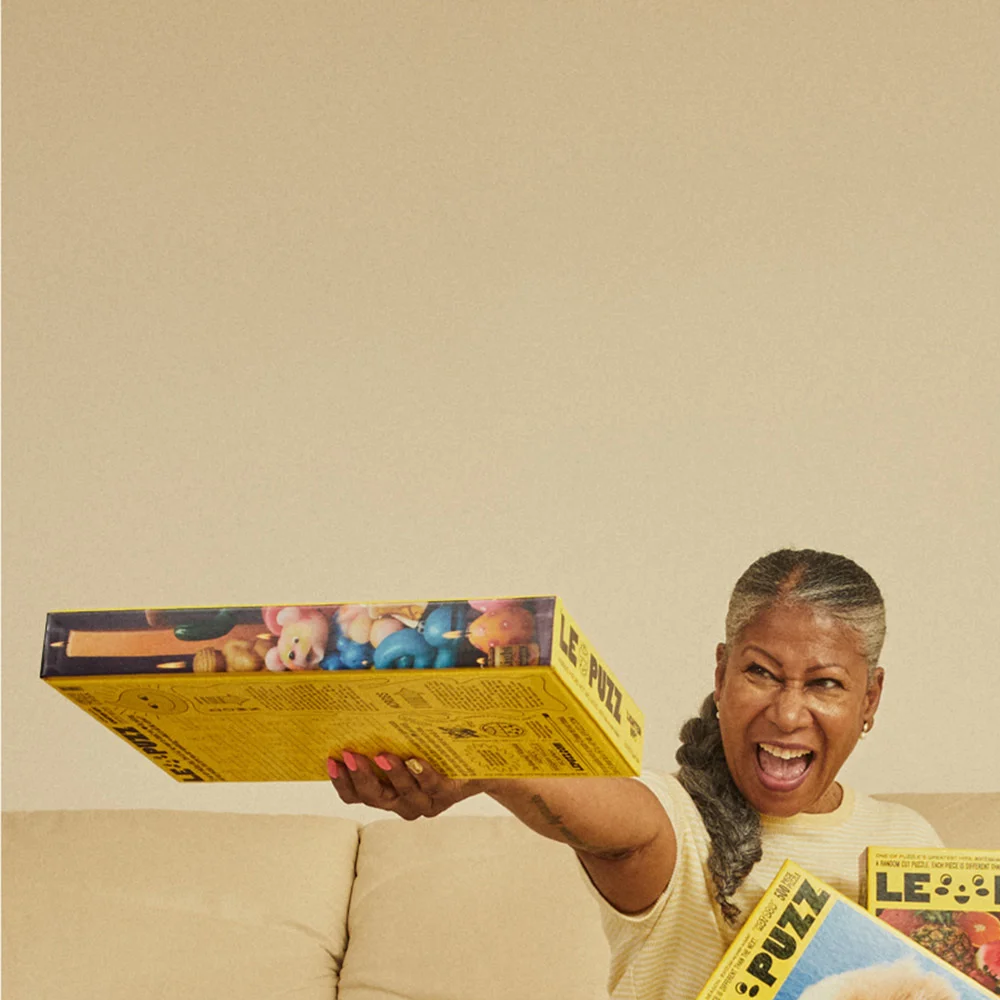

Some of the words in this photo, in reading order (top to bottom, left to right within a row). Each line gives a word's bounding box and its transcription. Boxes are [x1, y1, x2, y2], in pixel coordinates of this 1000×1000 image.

[560, 613, 578, 667] LE
[589, 653, 622, 725] PUZZ
[772, 883, 790, 901] 500
[875, 871, 930, 903] LE
[747, 879, 831, 987] PUZZ
